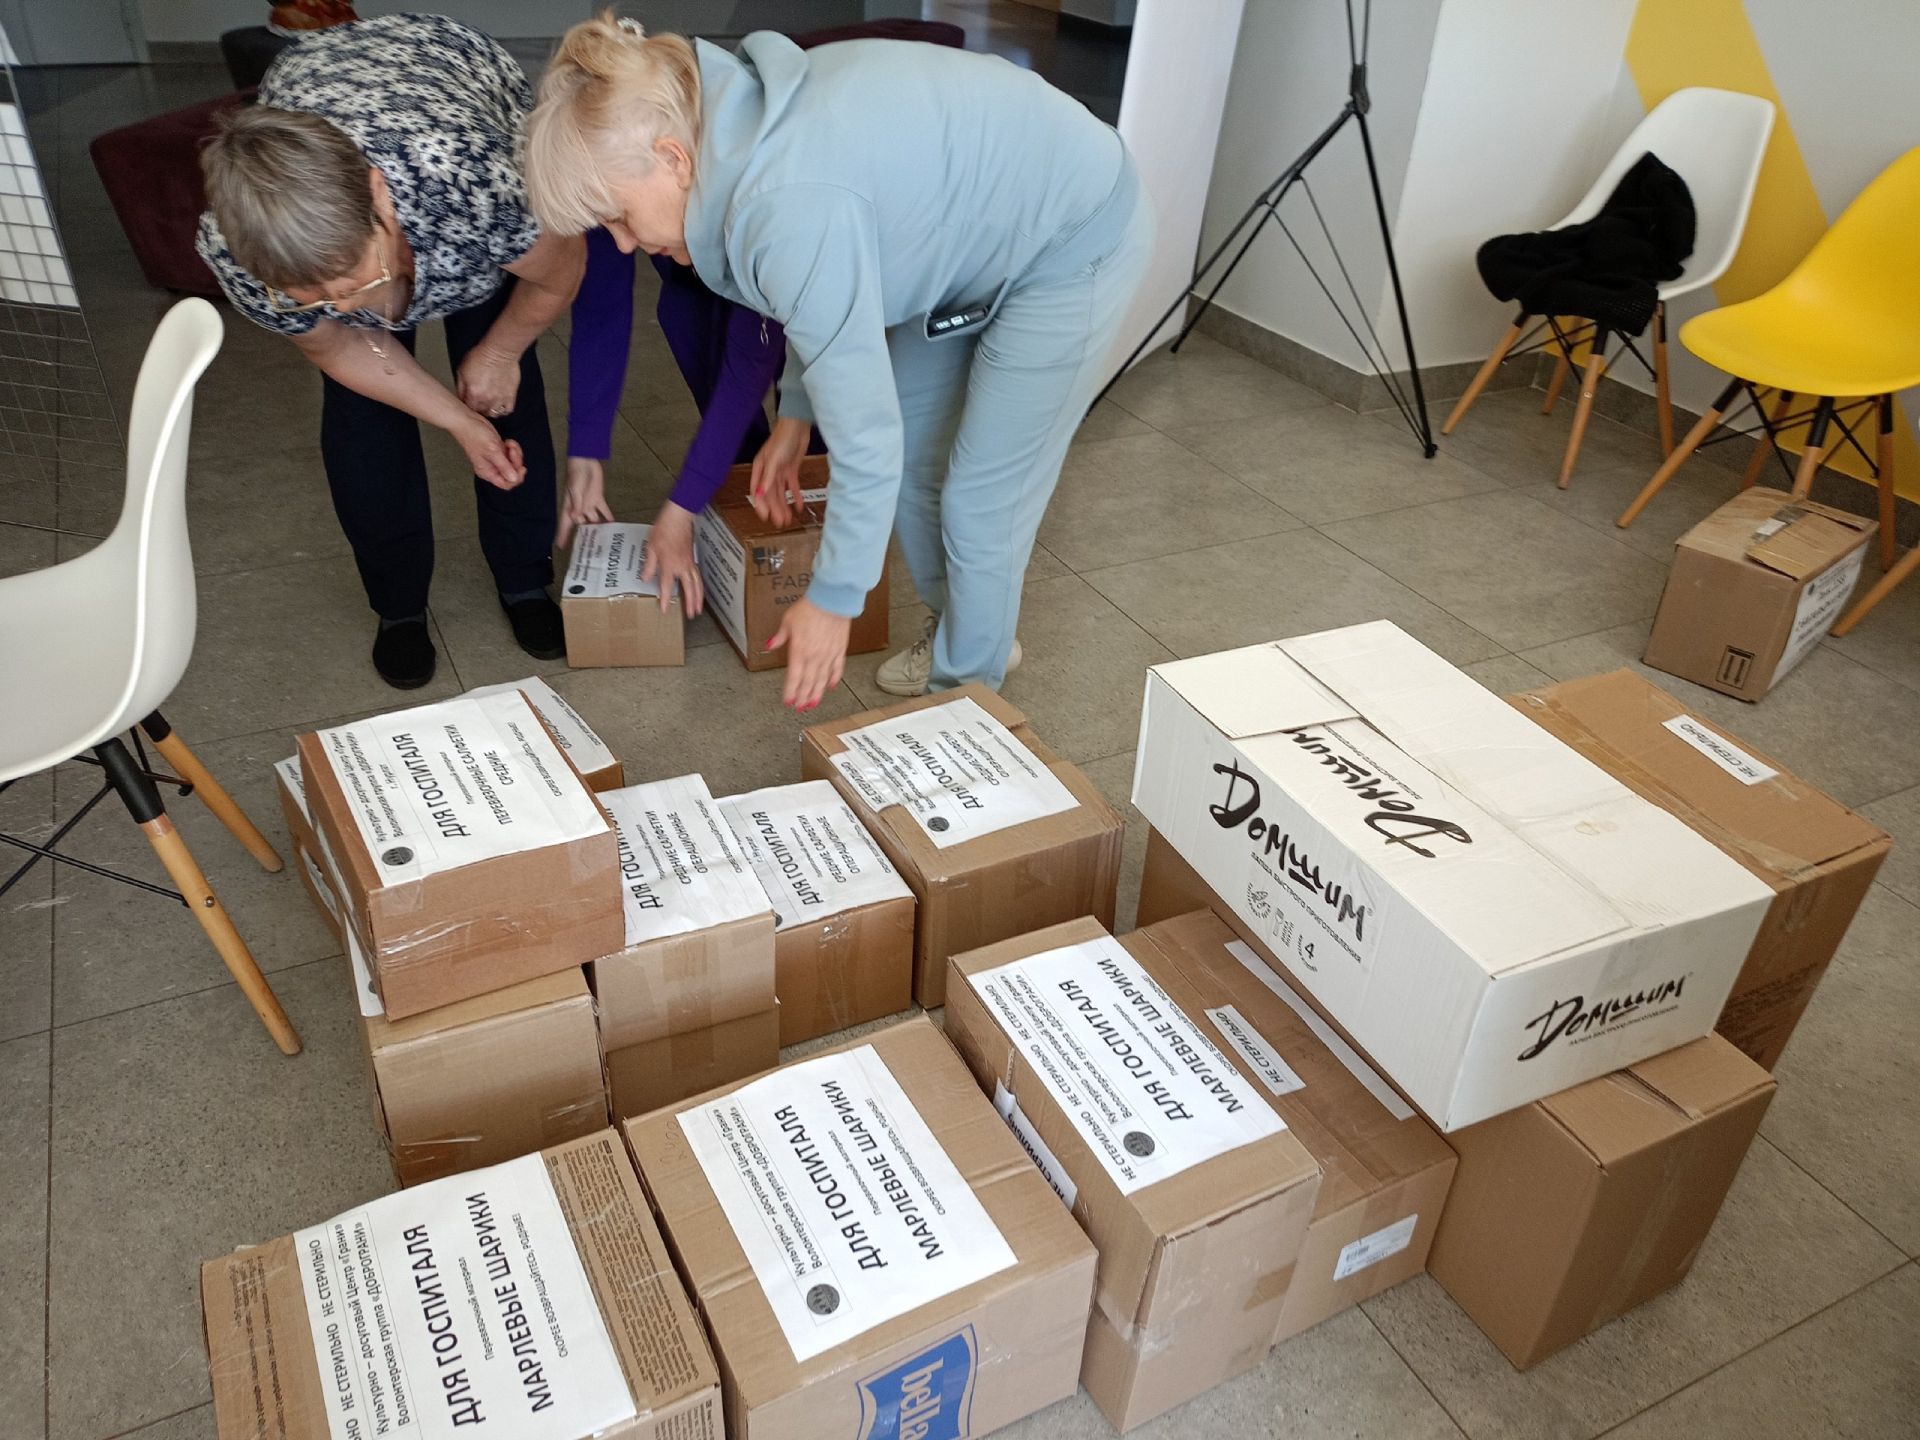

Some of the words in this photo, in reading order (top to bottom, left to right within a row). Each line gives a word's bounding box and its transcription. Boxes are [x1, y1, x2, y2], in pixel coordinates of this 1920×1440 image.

[444, 724, 475, 764] САЛФЕТКИ
[484, 750, 514, 785] СРЕДНИЕ
[896, 733, 958, 788] ГОСПИТАЛЯ
[1680, 724, 1742, 766] СТЕРИЛЬНО
[392, 734, 447, 808] ГОСПИТАЛЯ
[1738, 766, 1758, 777] НЕ
[950, 786, 984, 809] ДЛЯ
[432, 809, 471, 837] ДЛЯ
[607, 808, 644, 880] ГОСПИ
[645, 811, 673, 849] САЛФЕТКИ
[752, 812, 802, 878] ГОСПИТАЛЯ
[665, 849, 692, 884] СРЕДНИЕ
[630, 883, 663, 909] ДЛЯ
[792, 879, 824, 905] ДЛЯ
[1305, 943, 1315, 959] 4
[985, 985, 1022, 1028] СТЕРИЛЬНО
[1098, 959, 1162, 1021] ШАРИКИ
[1018, 1028, 1032, 1040] НЕ
[1059, 980, 1151, 1078] ГОСПИТАЛЯ
[1216, 1012, 1270, 1067] СТЕРИЛЬНО
[1030, 1044, 1071, 1093] СТЕРИЛЬНО
[1155, 1023, 1243, 1113] МАРЛЕВЫЕ
[1265, 1069, 1284, 1083] НЕ
[822, 1081, 877, 1152] ШАРИКИ
[1067, 1093, 1082, 1107] НЕ
[1144, 1081, 1193, 1120] ДЛЯ
[731, 1142, 749, 1168] Центр
[1081, 1112, 1125, 1165] СТЕРИЛЬНО
[766, 1171, 787, 1202] группа
[775, 1106, 853, 1220] ГОСПИТАЛЯ
[1121, 1166, 1136, 1180] НЕ
[742, 1168, 776, 1215] досуговый
[868, 1154, 943, 1259] МАРЛЕВЫЕ
[924, 1187, 946, 1215] СКОРЕЕ
[335, 1224, 351, 1264] «Грани»
[466, 1193, 510, 1280] ШАРИКИ
[775, 1224, 806, 1276] Культурно
[782, 1202, 822, 1269] Волонтерская
[841, 1222, 888, 1270] ДЛЯ
[309, 1240, 331, 1300] СТЕРИЛЬНО
[344, 1266, 359, 1299] Центр
[354, 1223, 382, 1302] «ДОБРОГРАНИ»
[458, 1257, 475, 1296] материал
[321, 1300, 335, 1317] НЕ
[404, 1225, 461, 1366] ГОСПИТАЛЯ
[527, 1250, 557, 1324] ВОЗВРАЩАЙТЕСЬ,
[348, 1299, 374, 1358] досуговый
[374, 1304, 392, 1342] группа
[468, 1296, 494, 1360] Перевязочный
[550, 1324, 568, 1358] СКОРЕЕ
[326, 1323, 350, 1392] СТЕРИЛЬНО
[495, 1283, 553, 1412] МАРЛЕВЫЕ
[340, 1392, 354, 1411] НЕ
[368, 1371, 390, 1435] Культурно
[384, 1344, 410, 1426] Волонтерская
[442, 1369, 486, 1426] ДЛЯ
[900, 1356, 943, 1440] bella
